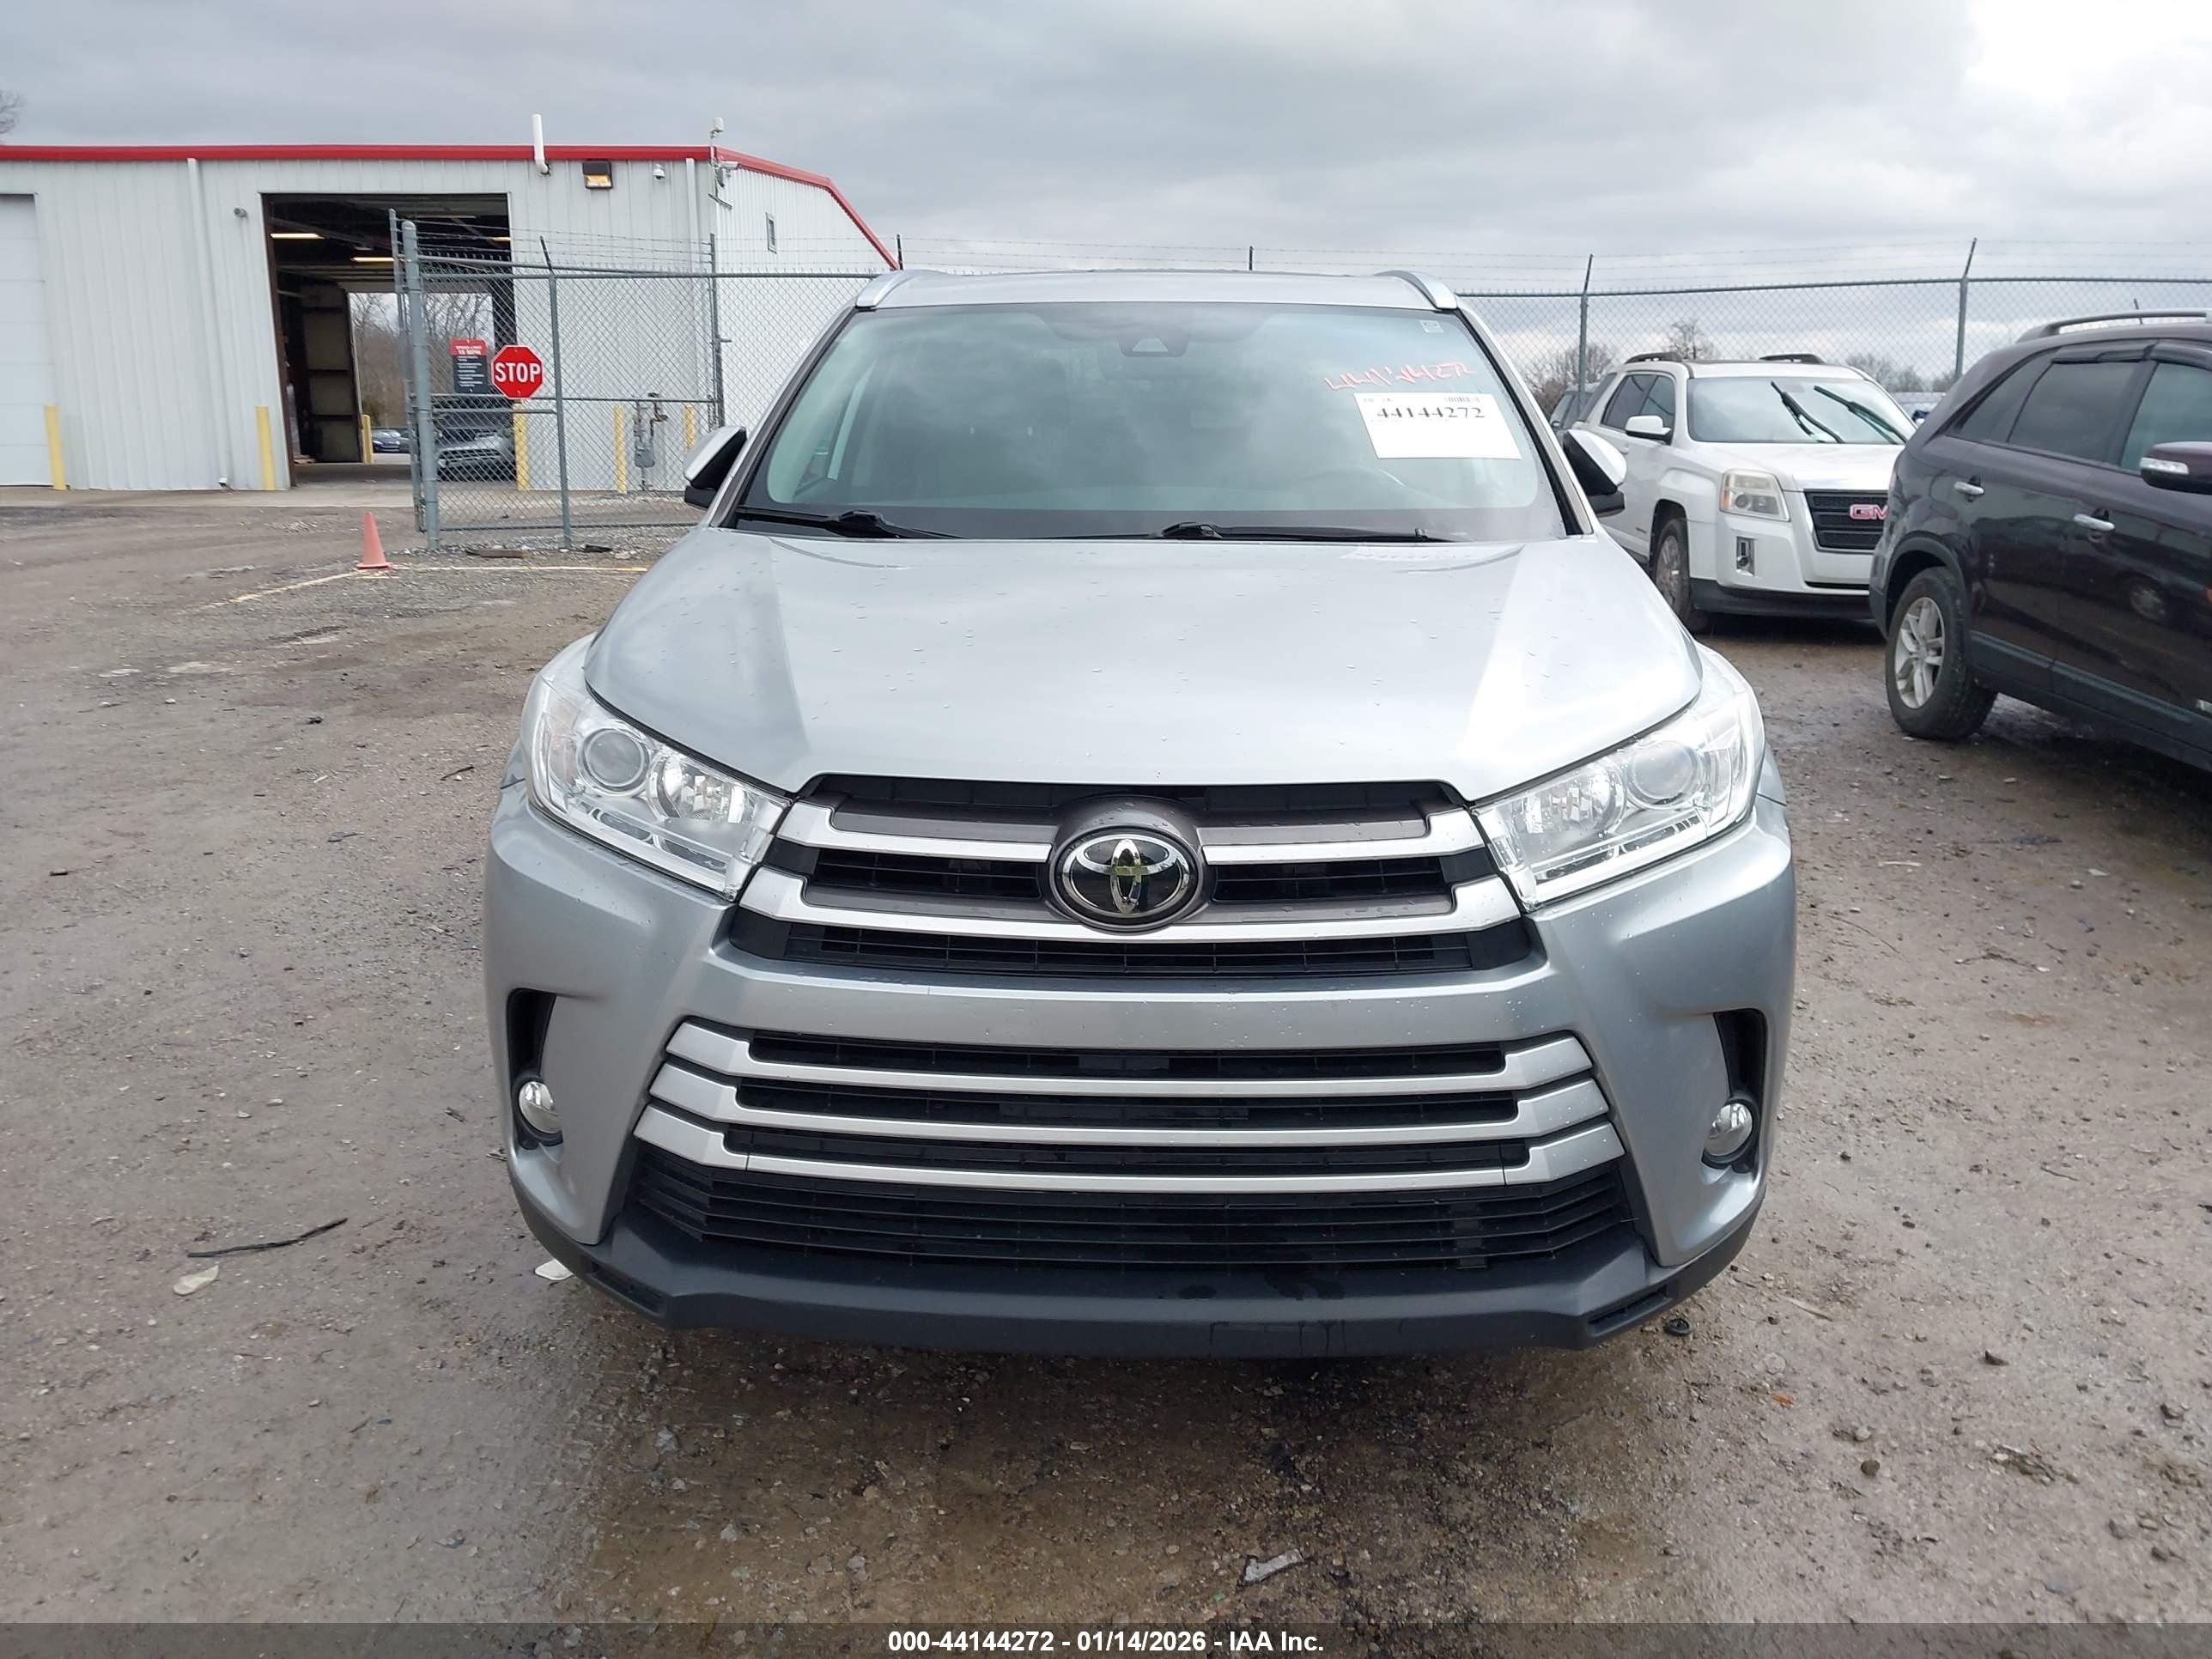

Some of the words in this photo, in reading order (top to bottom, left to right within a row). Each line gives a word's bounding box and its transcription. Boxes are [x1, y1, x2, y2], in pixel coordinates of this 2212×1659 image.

[495, 362, 541, 383] STOP
[1376, 407, 1486, 418] 44144272
[1850, 504, 1888, 520] GM
